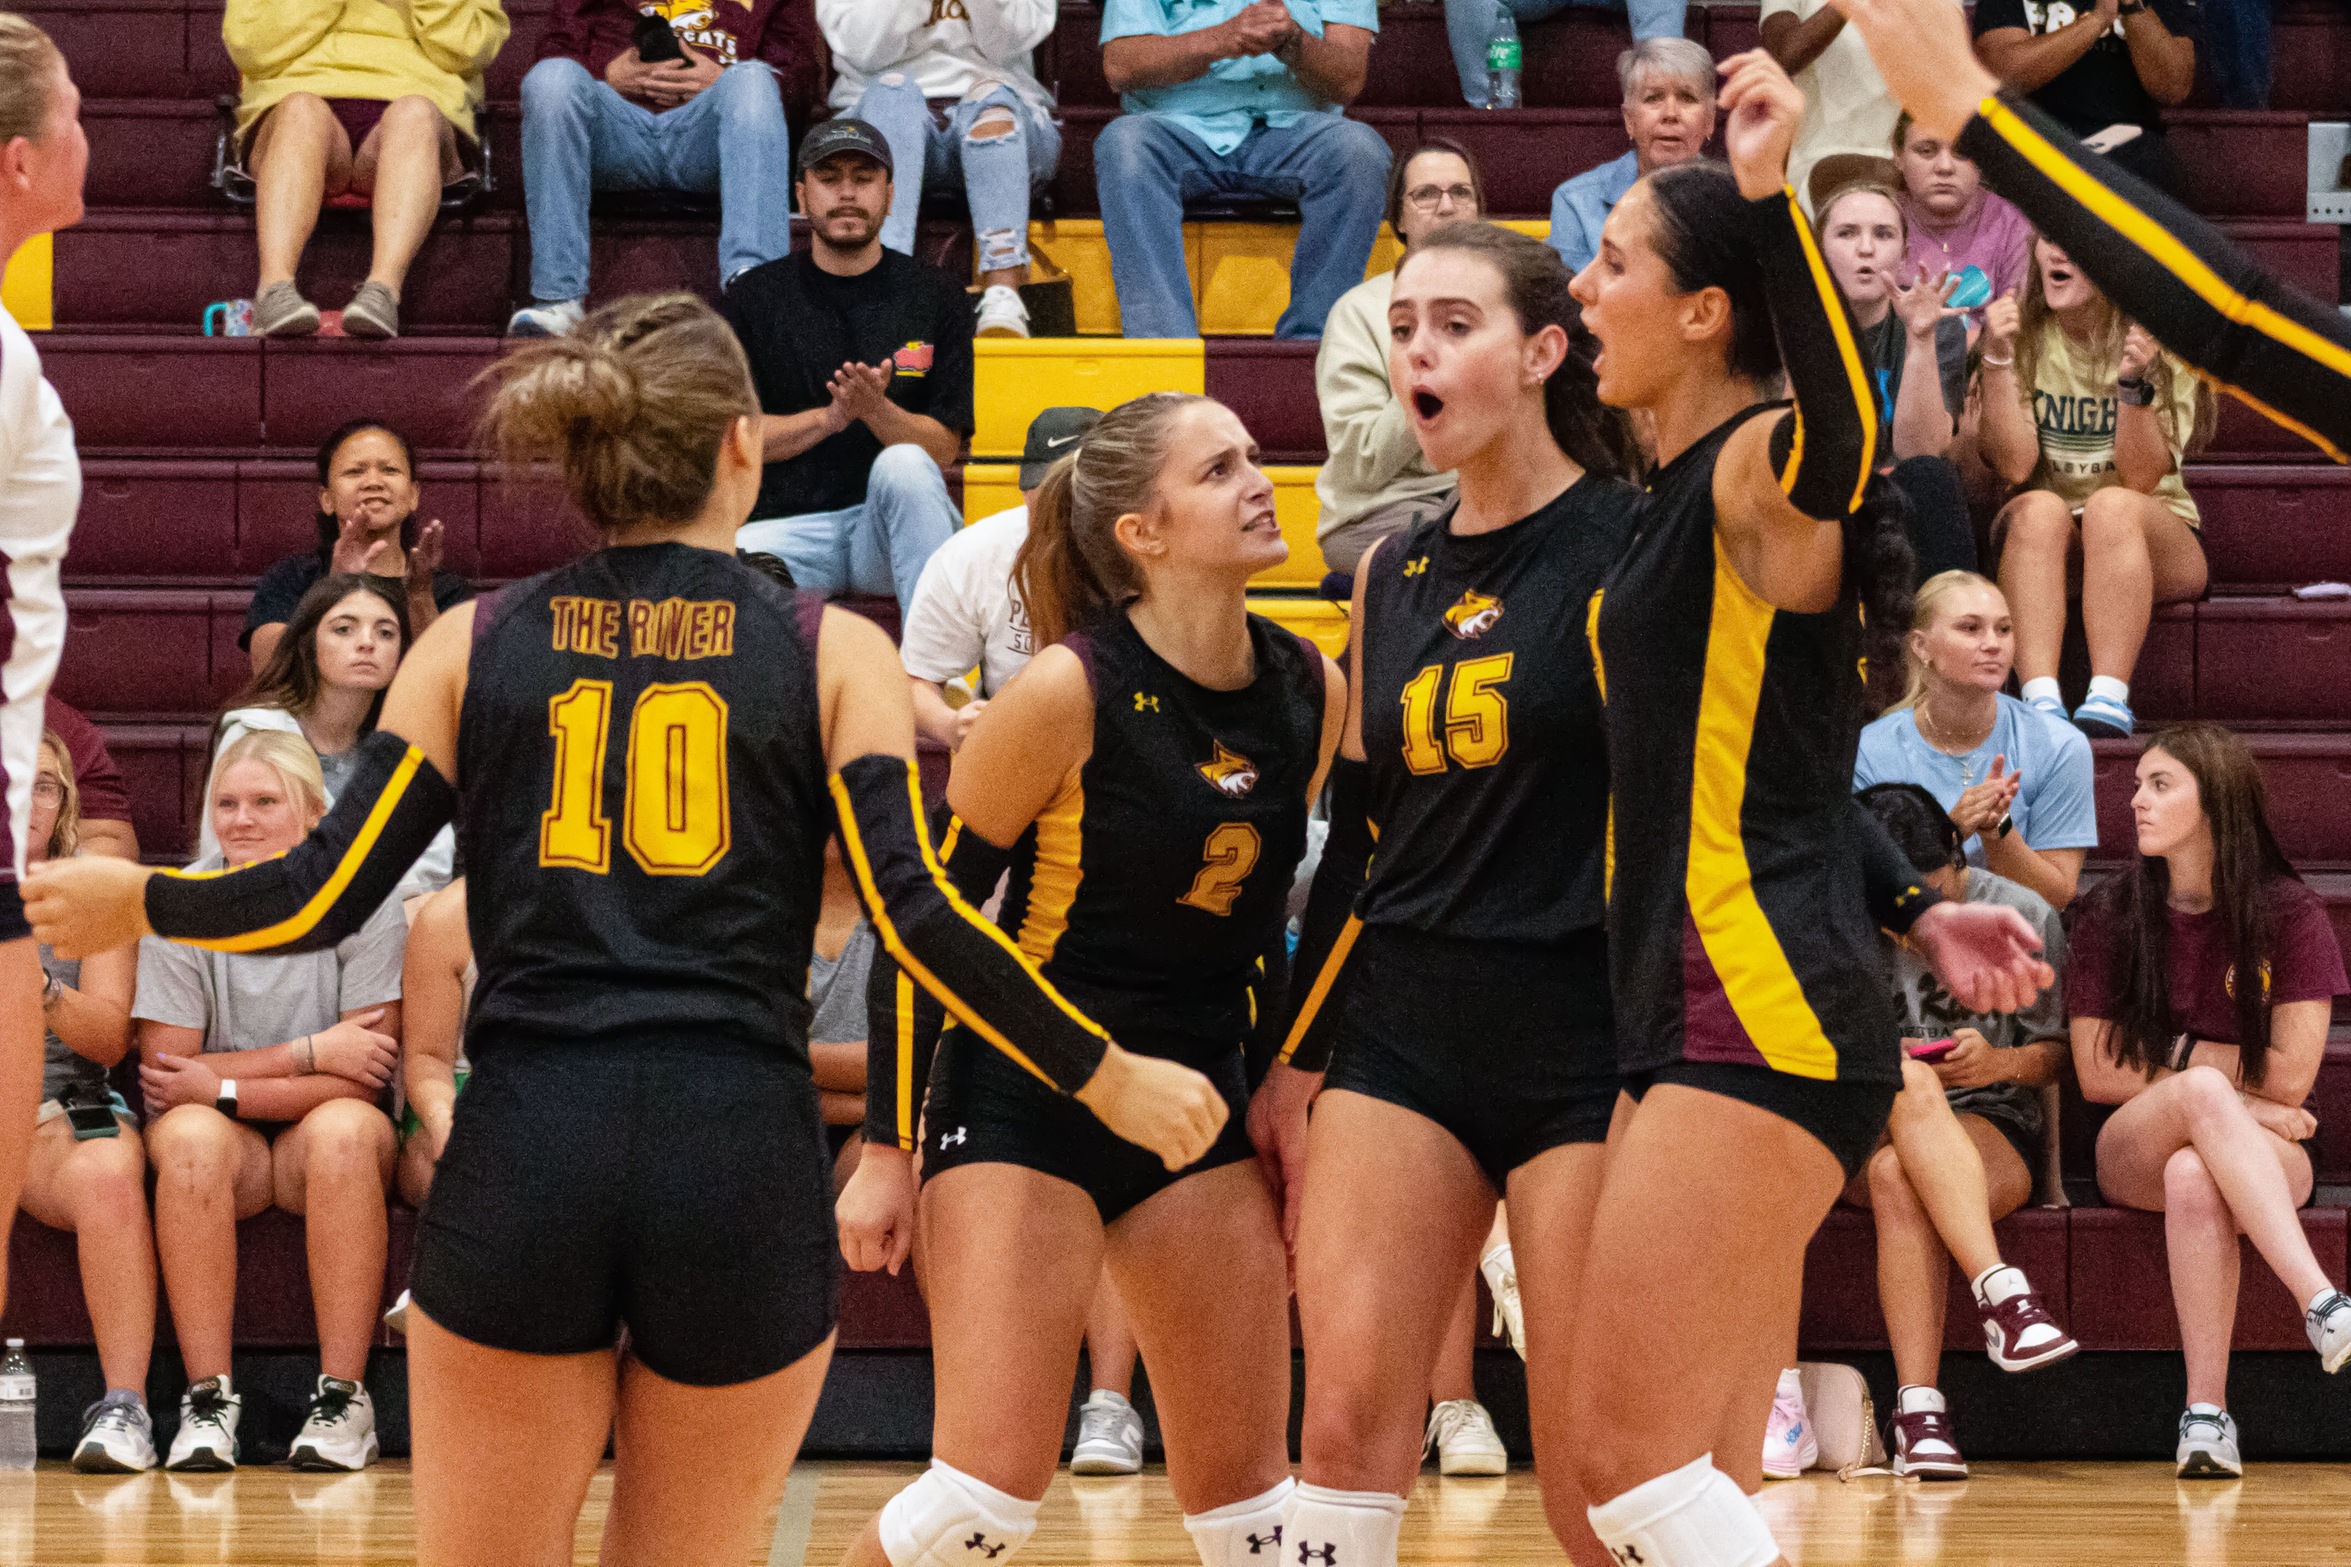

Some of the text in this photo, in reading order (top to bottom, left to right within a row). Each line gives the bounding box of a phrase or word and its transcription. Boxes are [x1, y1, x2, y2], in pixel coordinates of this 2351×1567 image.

[680, 30, 737, 56] CATS
[550, 595, 736, 661] THE RIVER
[1400, 651, 1515, 776] 15
[538, 677, 732, 877] 10
[1175, 821, 1262, 917] 2
